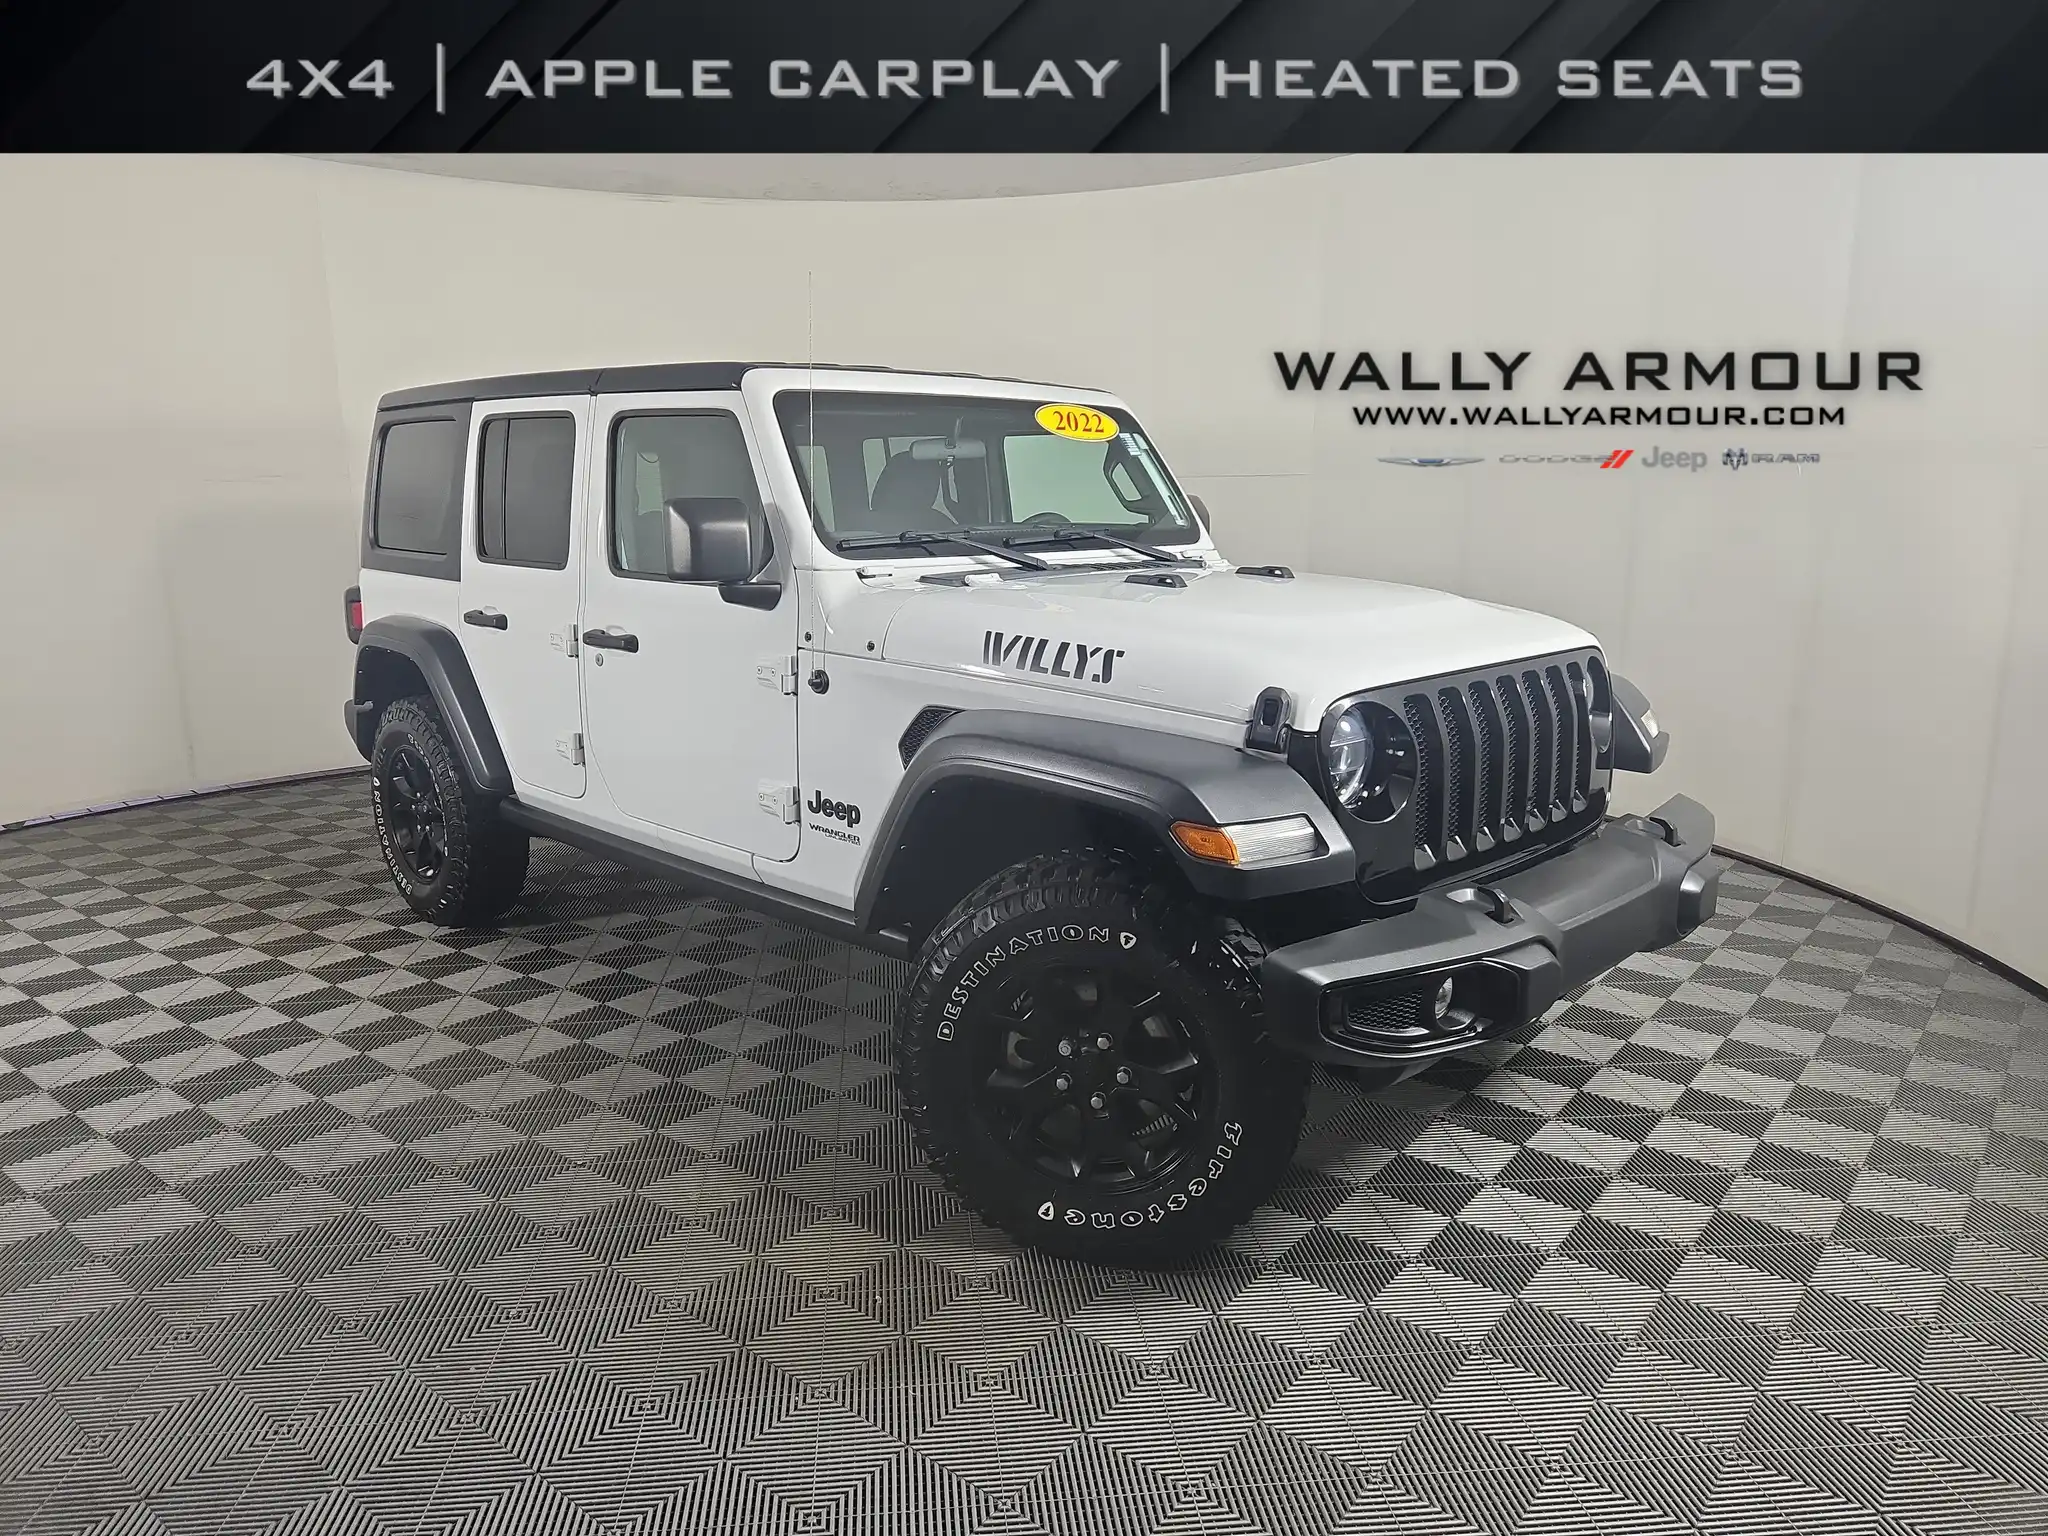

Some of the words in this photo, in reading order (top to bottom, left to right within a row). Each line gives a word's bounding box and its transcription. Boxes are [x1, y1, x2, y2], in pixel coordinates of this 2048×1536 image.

[1053, 410, 1105, 434] 2022
[982, 630, 1126, 685] WILLYS
[807, 789, 861, 829] Jeep
[808, 822, 861, 842] WRANGLER
[936, 924, 1110, 1042] DESTINATION
[1063, 1121, 1243, 1229] Firestone
